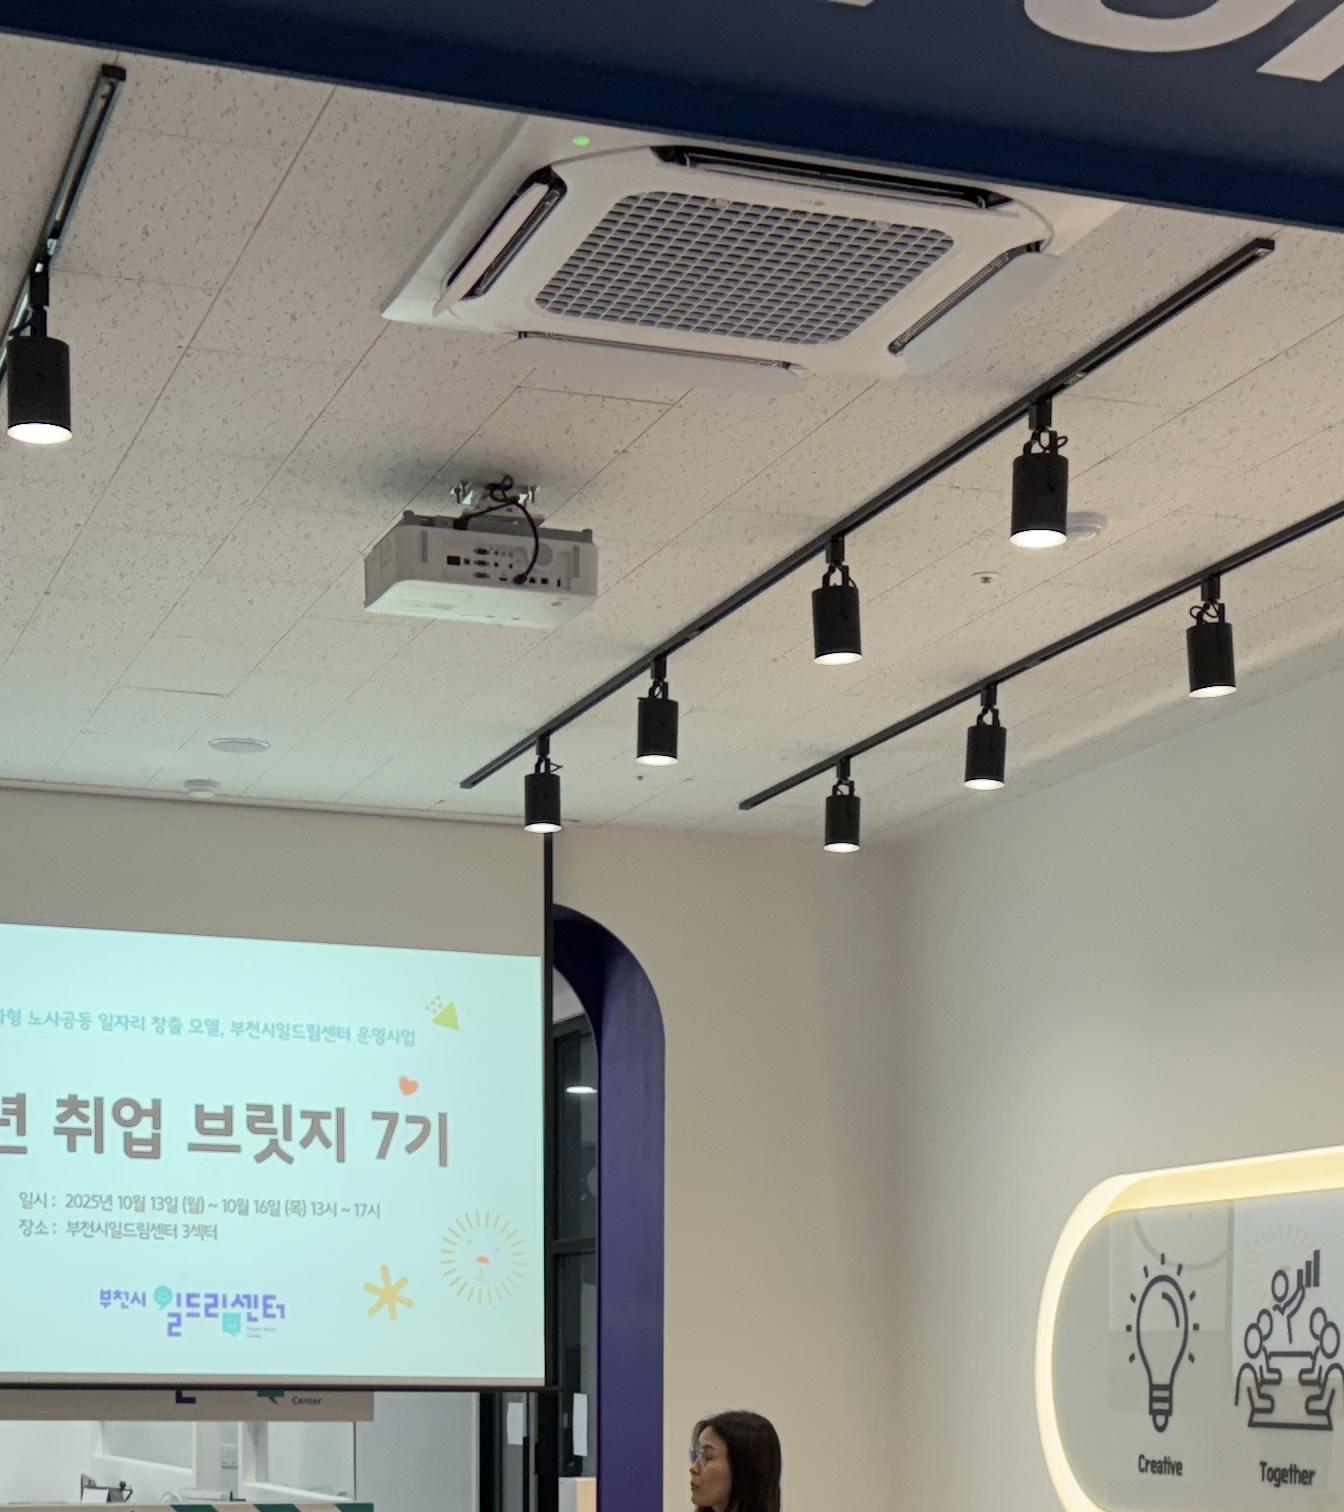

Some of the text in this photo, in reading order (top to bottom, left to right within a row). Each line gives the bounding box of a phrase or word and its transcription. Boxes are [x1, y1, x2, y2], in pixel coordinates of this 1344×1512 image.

[28, 1010, 92, 1030] 노사공동
[98, 1013, 145, 1031] 일자리
[151, 1015, 183, 1035] 창출
[188, 1017, 224, 1039] 모델,
[230, 1020, 352, 1043] 부천시일드림센터
[356, 1025, 416, 1047] 운영사업
[53, 1093, 162, 1160] 취업
[187, 1103, 346, 1165] 브릿지
[371, 1110, 448, 1168] 7기
[19, 1191, 47, 1210] 일시
[65, 1193, 113, 1211] 2025년
[118, 1194, 146, 1213] 10월
[151, 1195, 179, 1214] 13일
[182, 1195, 205, 1215] (월)
[222, 1198, 249, 1216] 10월
[254, 1198, 281, 1218] 16일
[284, 1199, 306, 1218] (목)
[311, 1200, 338, 1218] 13시
[354, 1202, 381, 1219] 17시
[19, 1218, 49, 1238] 장소
[66, 1219, 178, 1240] 부천시일드림센터
[182, 1223, 218, 1242] 3섹터
[99, 1288, 146, 1309] 부천시
[1137, 1453, 1183, 1477] Creative
[1259, 1460, 1316, 1488] Together
